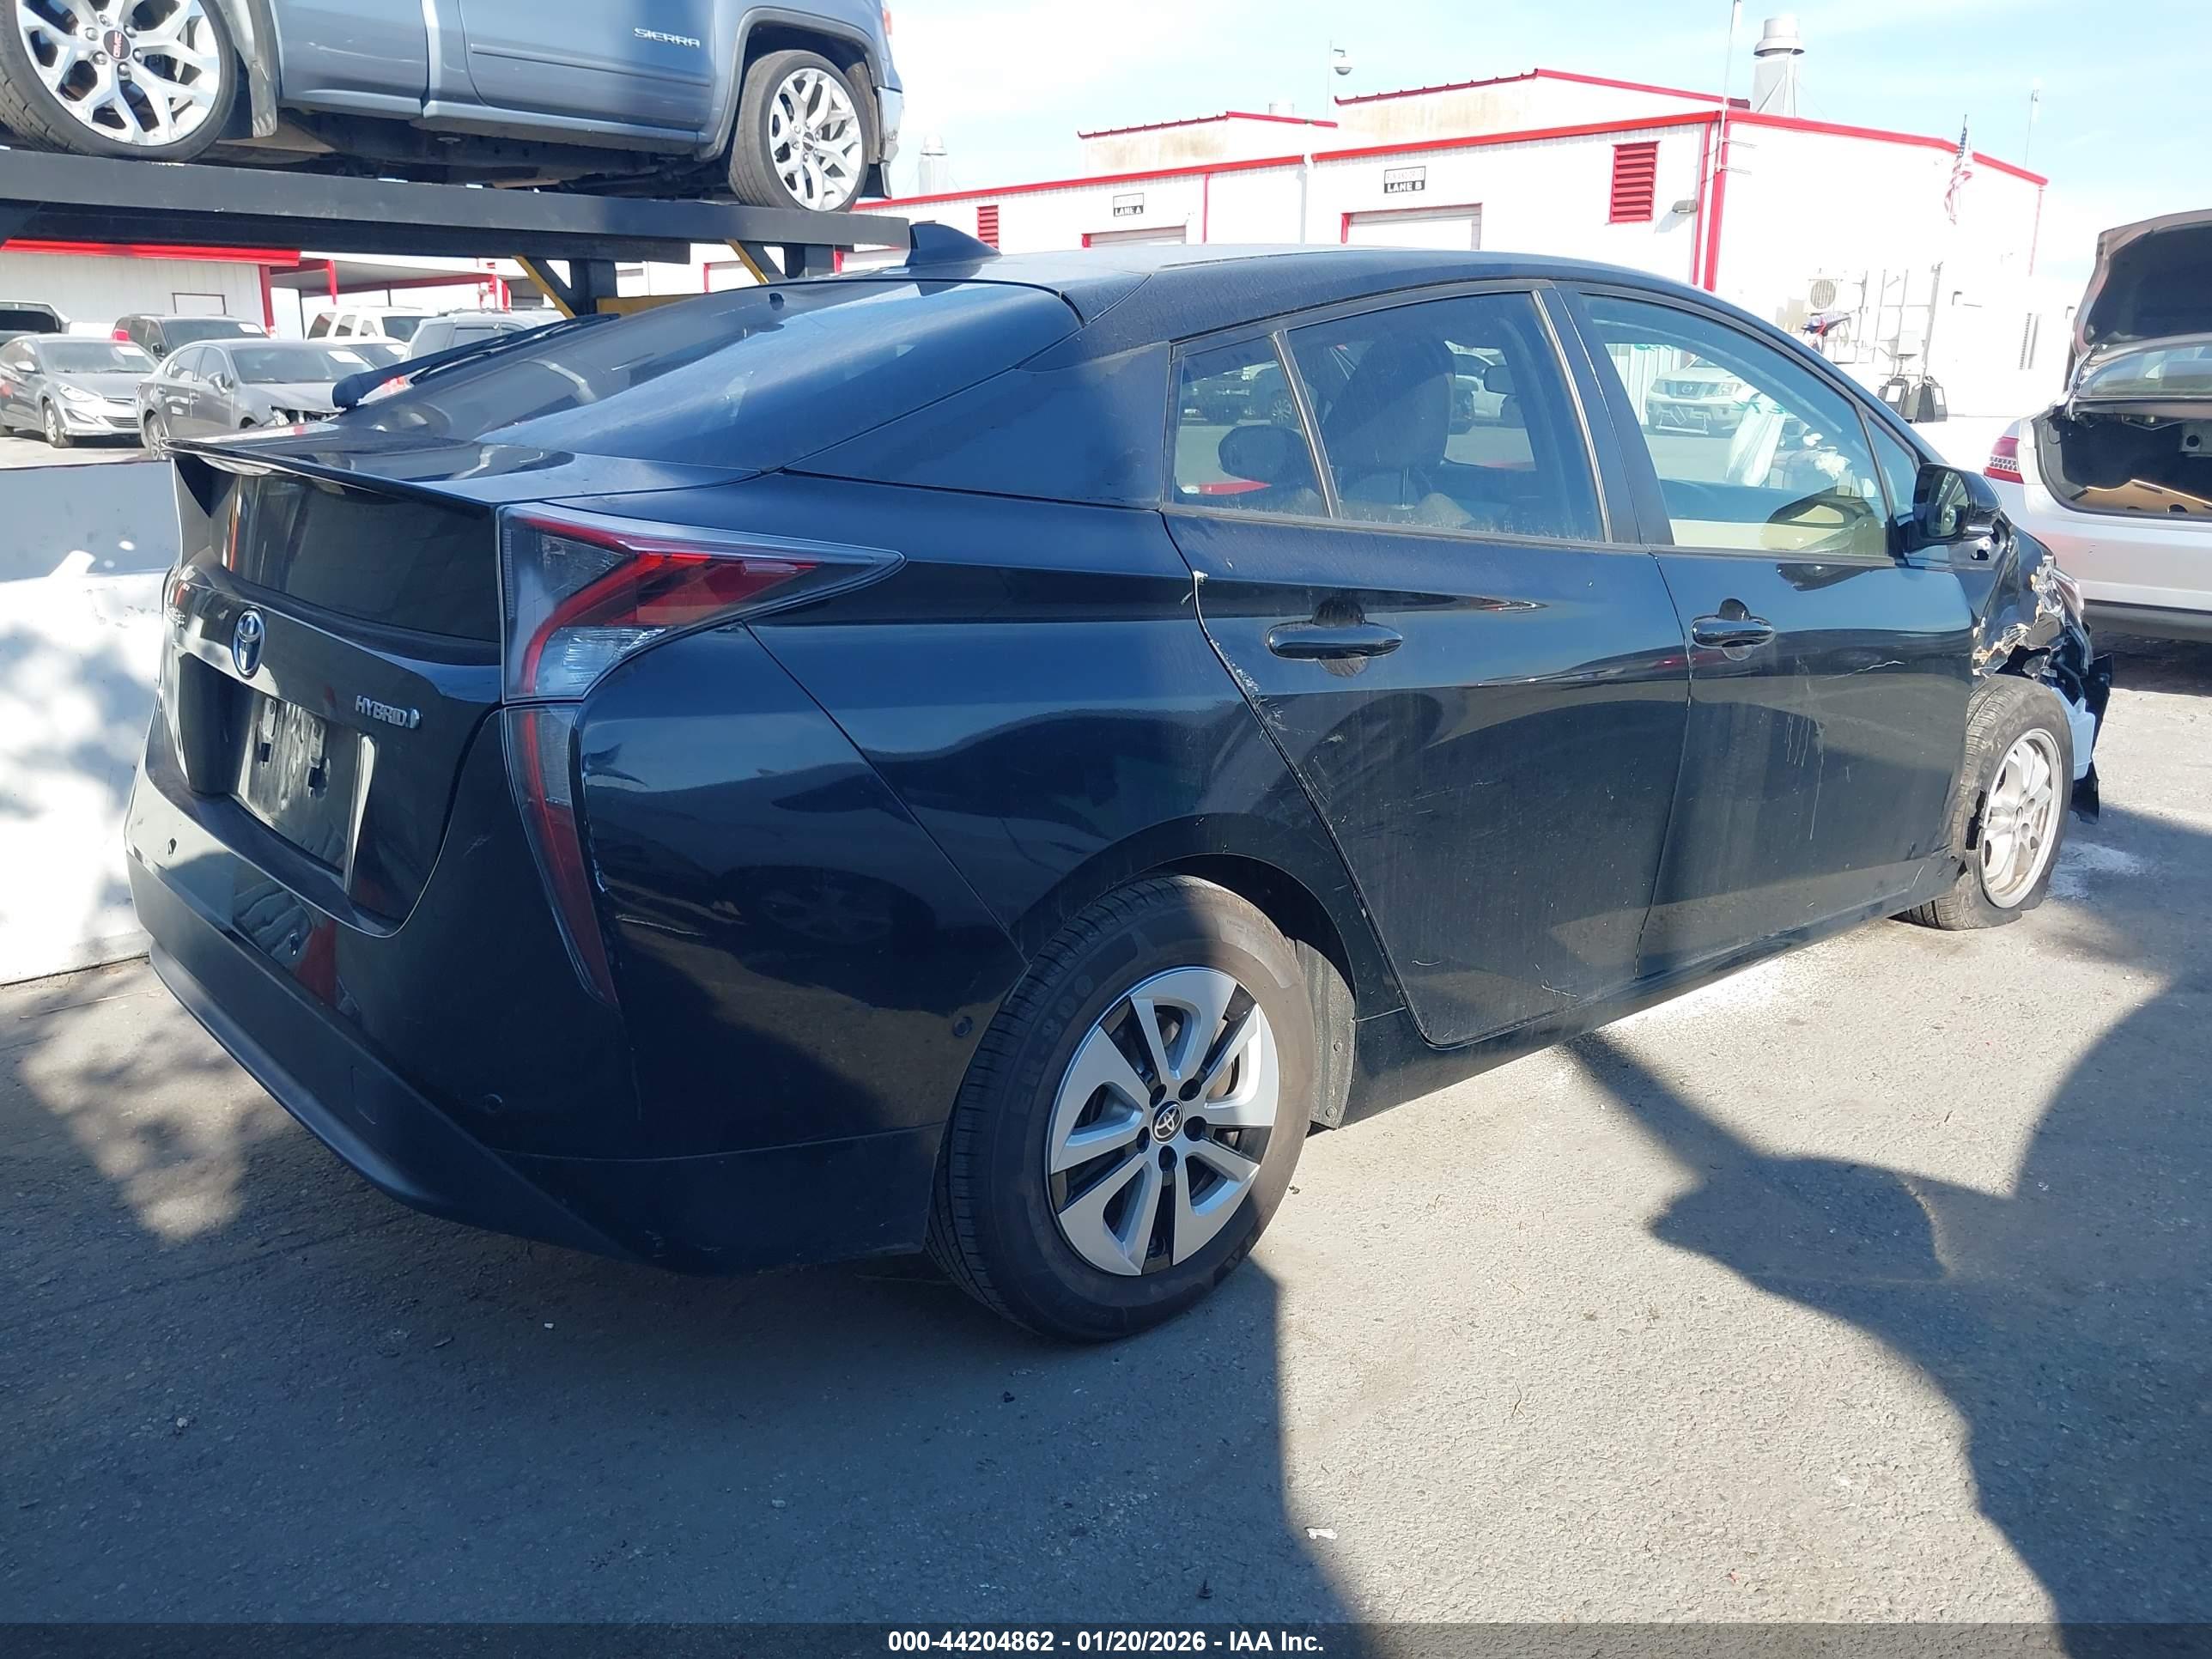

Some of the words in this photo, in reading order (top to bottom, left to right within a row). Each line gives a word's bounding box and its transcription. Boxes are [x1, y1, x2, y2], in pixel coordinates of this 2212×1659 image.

[634, 27, 701, 49] SIERRA
[1387, 182, 1413, 193] LANE
[1415, 181, 1423, 190] B
[356, 695, 408, 726] HYBRID
